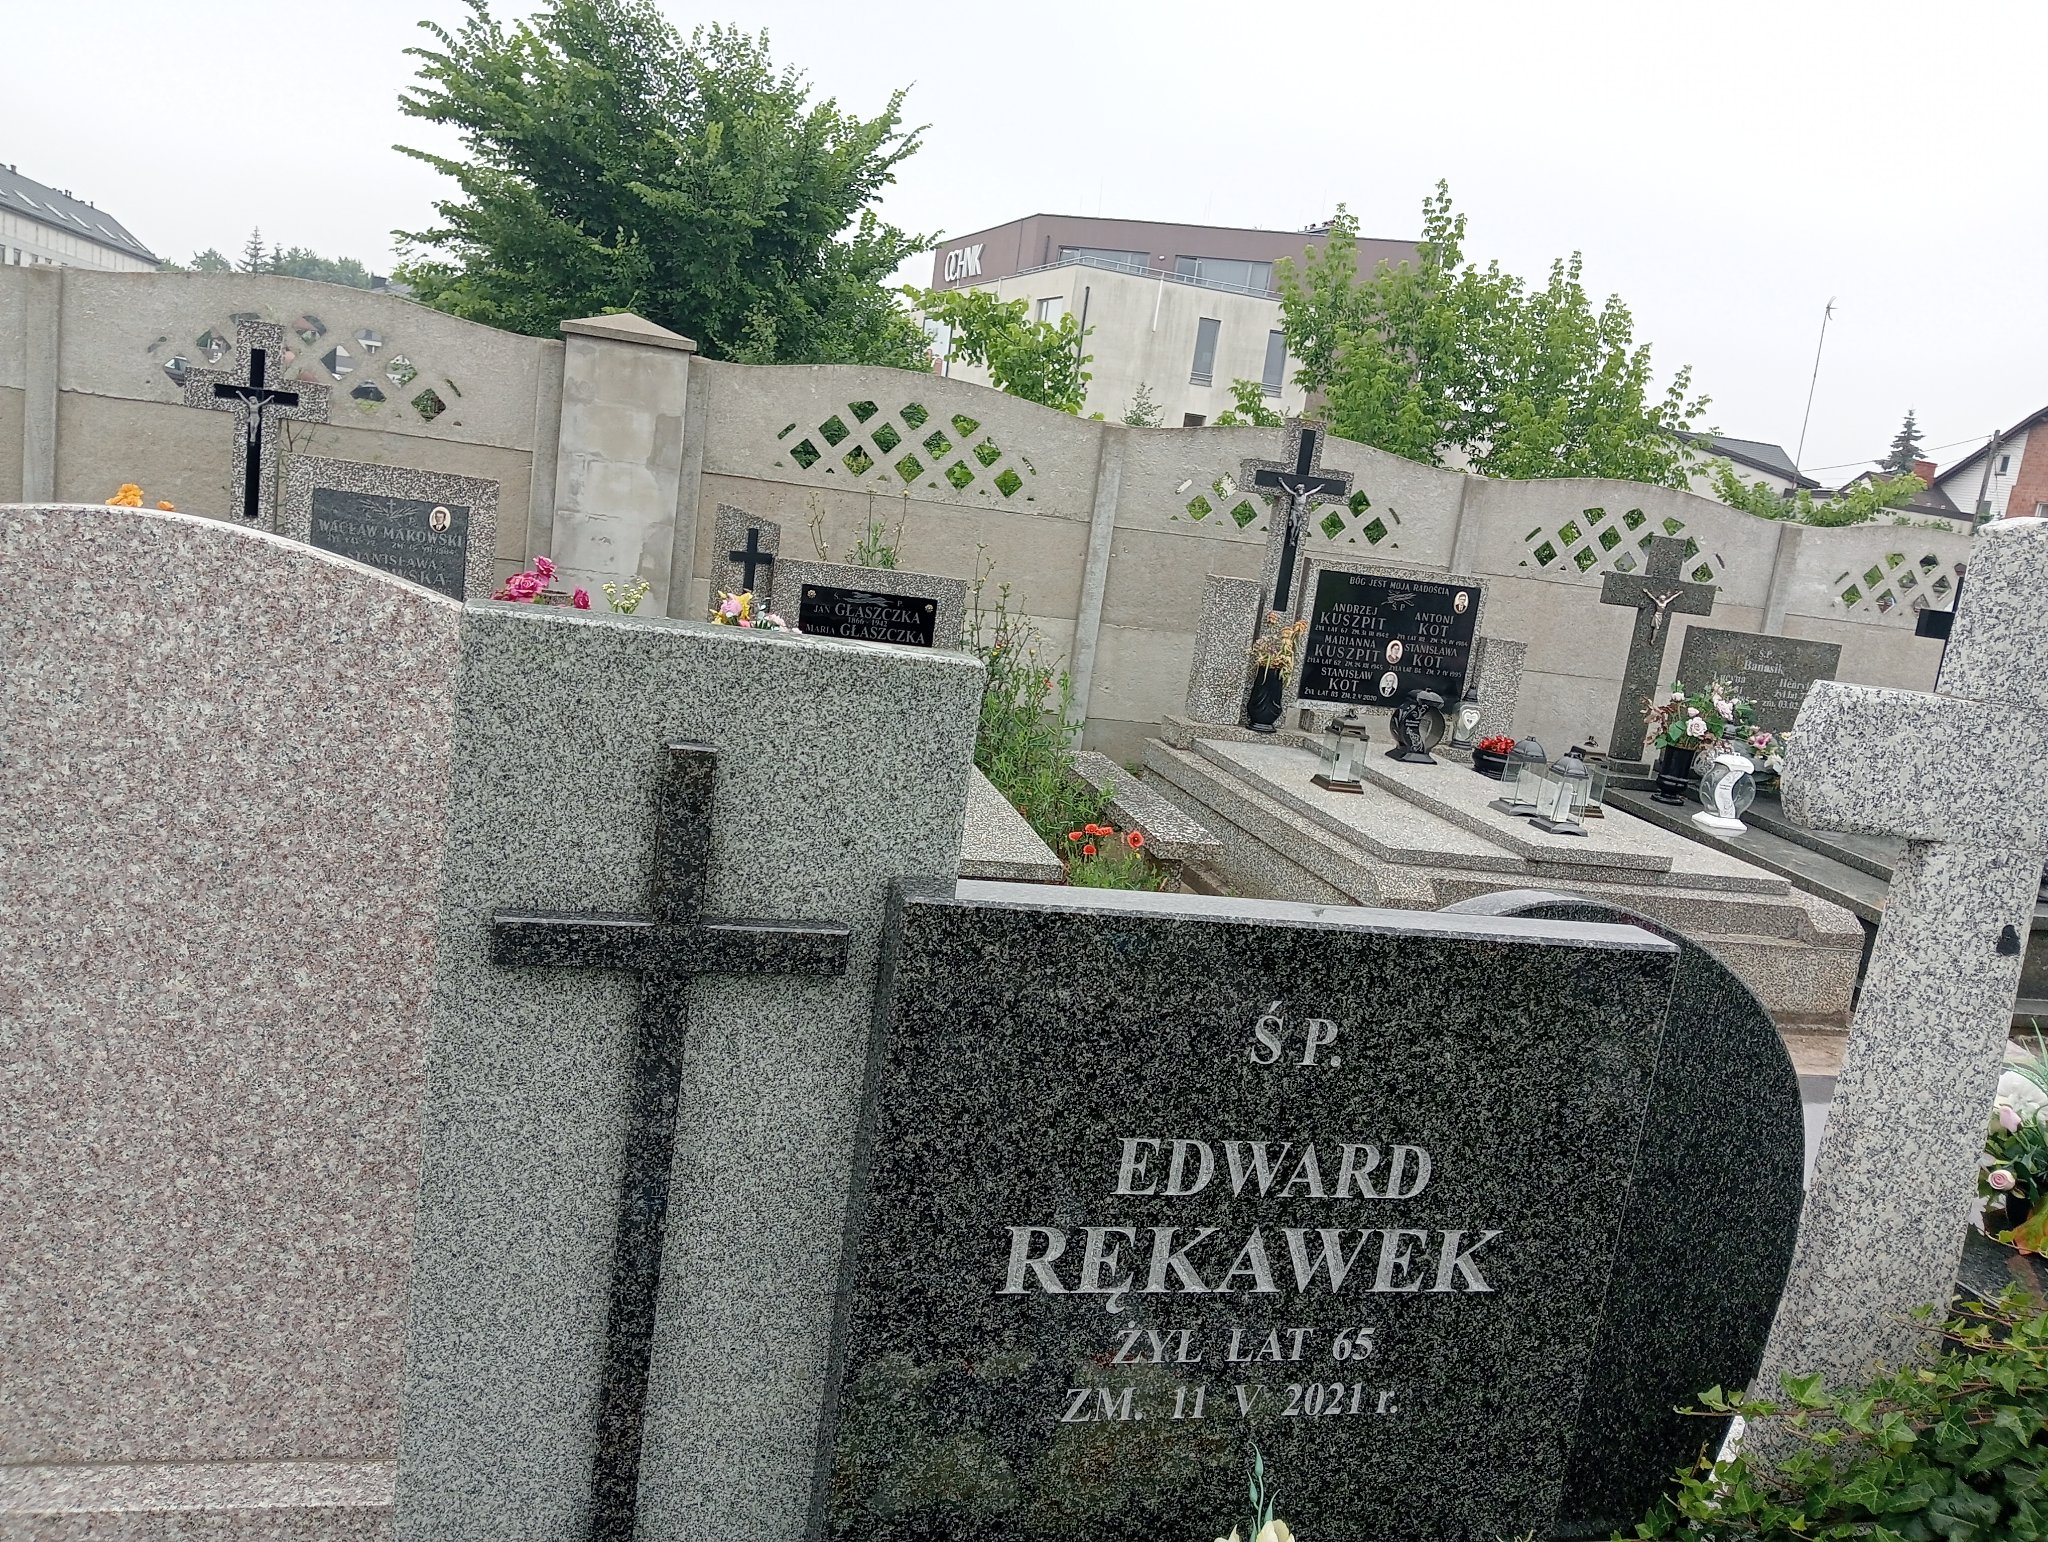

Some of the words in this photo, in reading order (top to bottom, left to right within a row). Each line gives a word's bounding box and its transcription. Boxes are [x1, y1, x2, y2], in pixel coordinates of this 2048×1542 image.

[318, 518, 378, 538] WACŁAW
[383, 526, 462, 548] MAKOWSKI
[347, 550, 437, 570] STANISŁAWA
[1350, 576, 1366, 586] BÓG
[1368, 579, 1388, 588] JEST
[814, 604, 830, 614] JAN
[834, 602, 920, 624] GŁASZCZKA
[1333, 602, 1378, 616] ANDRZEJ
[848, 616, 864, 625] 1866
[871, 619, 888, 628] 1942
[1320, 611, 1386, 630] KUSZPIT
[1414, 612, 1454, 625] ANTONI
[840, 623, 925, 644] GŁASZCZKA
[1418, 622, 1449, 637] KOT
[1324, 634, 1376, 649] MARIANNA
[1404, 643, 1458, 657] STANISŁAWA
[1314, 644, 1380, 662] KUSZPIT
[1412, 654, 1444, 668] KOT
[1321, 666, 1374, 680] STANISŁAW
[1744, 660, 1785, 676] Banasik
[1328, 678, 1360, 692] KOT
[1296, 1017, 1341, 1068] P.
[1111, 1136, 1433, 1199] EDWARD
[996, 1225, 1504, 1315] RĘKAWEK
[1112, 1320, 1203, 1364] ŻYŁ
[1226, 1327, 1315, 1362] LAT
[1332, 1326, 1376, 1361] 65
[1060, 1386, 1144, 1424] ZM.
[1171, 1385, 1207, 1419] 11
[1235, 1384, 1264, 1418] V
[1282, 1382, 1363, 1417] 2021
[1375, 1391, 1399, 1414] r.
